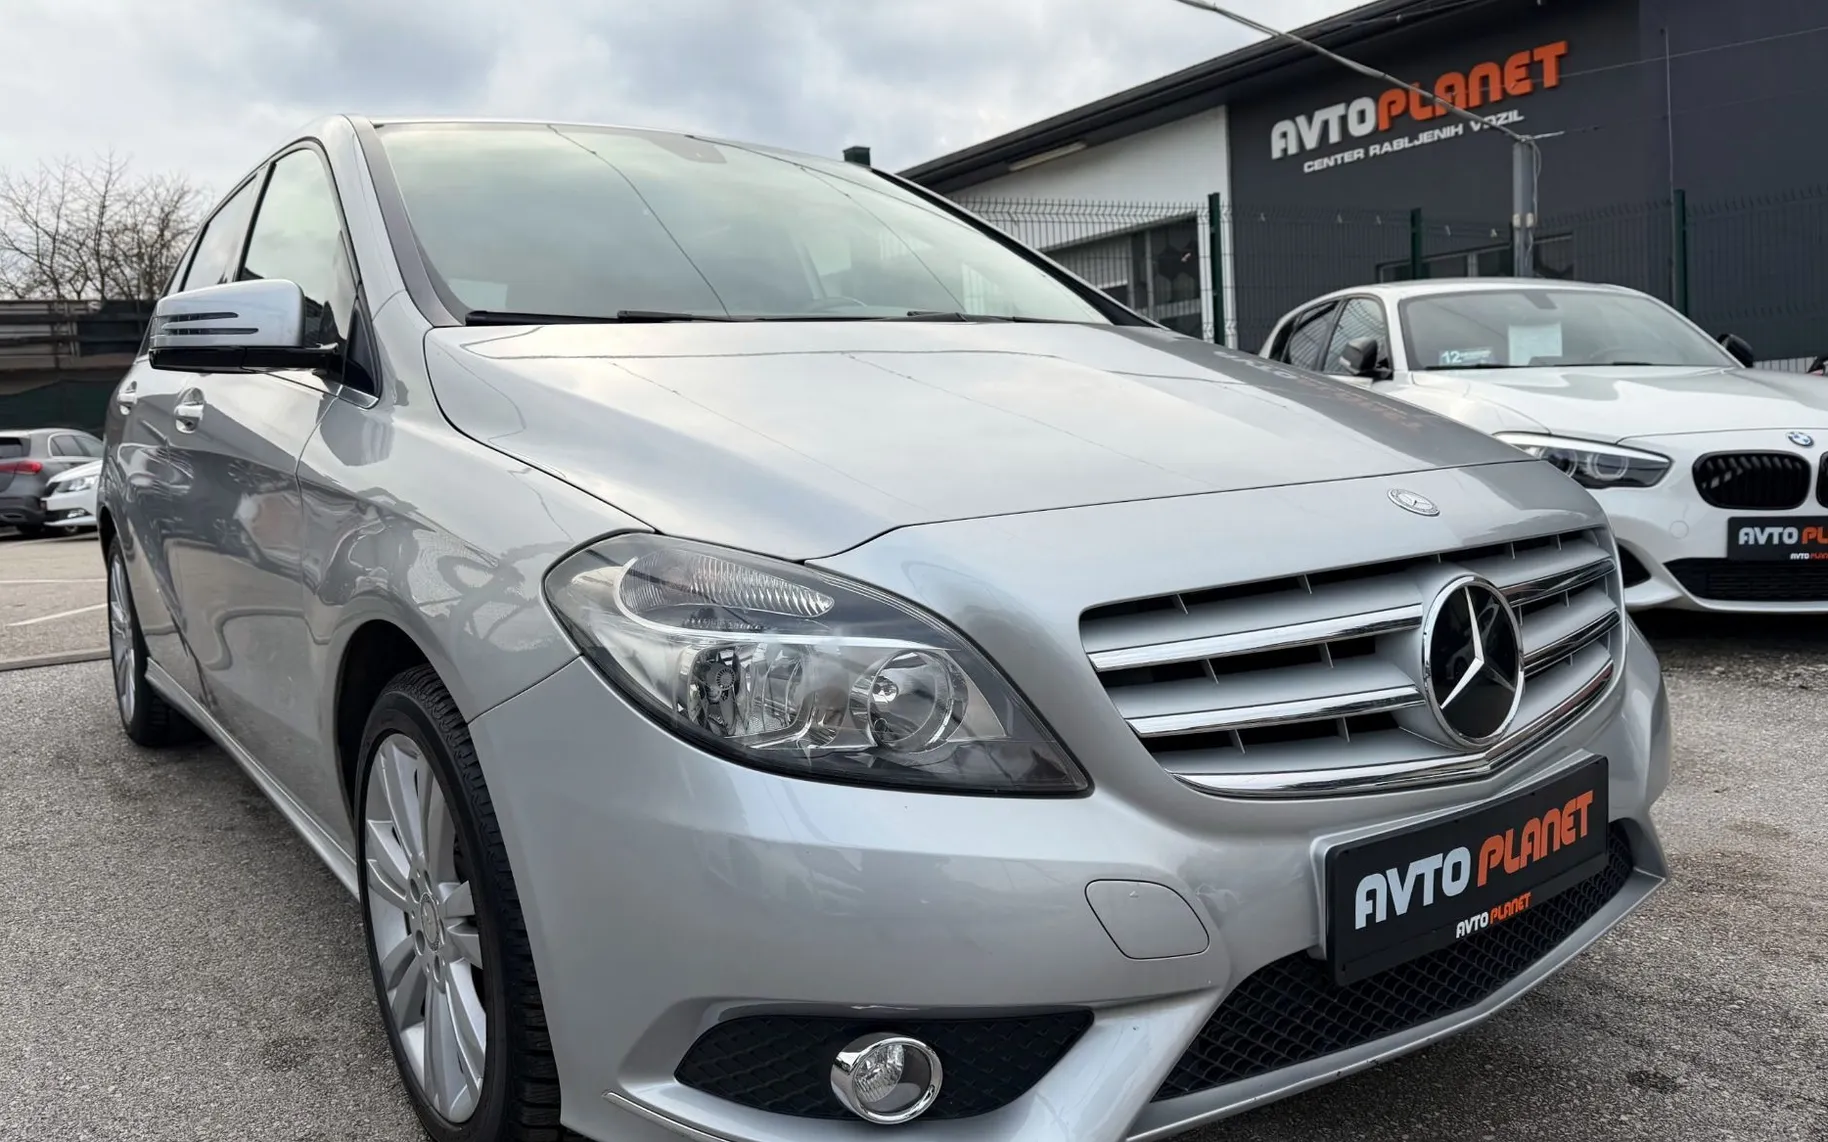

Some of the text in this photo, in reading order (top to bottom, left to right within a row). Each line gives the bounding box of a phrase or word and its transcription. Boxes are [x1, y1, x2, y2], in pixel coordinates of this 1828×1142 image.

[1303, 148, 1365, 173] CENTER
[1369, 123, 1464, 157] RABLJENIH
[1441, 350, 1462, 364] 12
[1738, 526, 1799, 545] AVTO
[1790, 552, 1810, 560] AVTO
[1355, 791, 1594, 930] AVTO PLANET
[1455, 891, 1532, 939] AVTO PLANET
